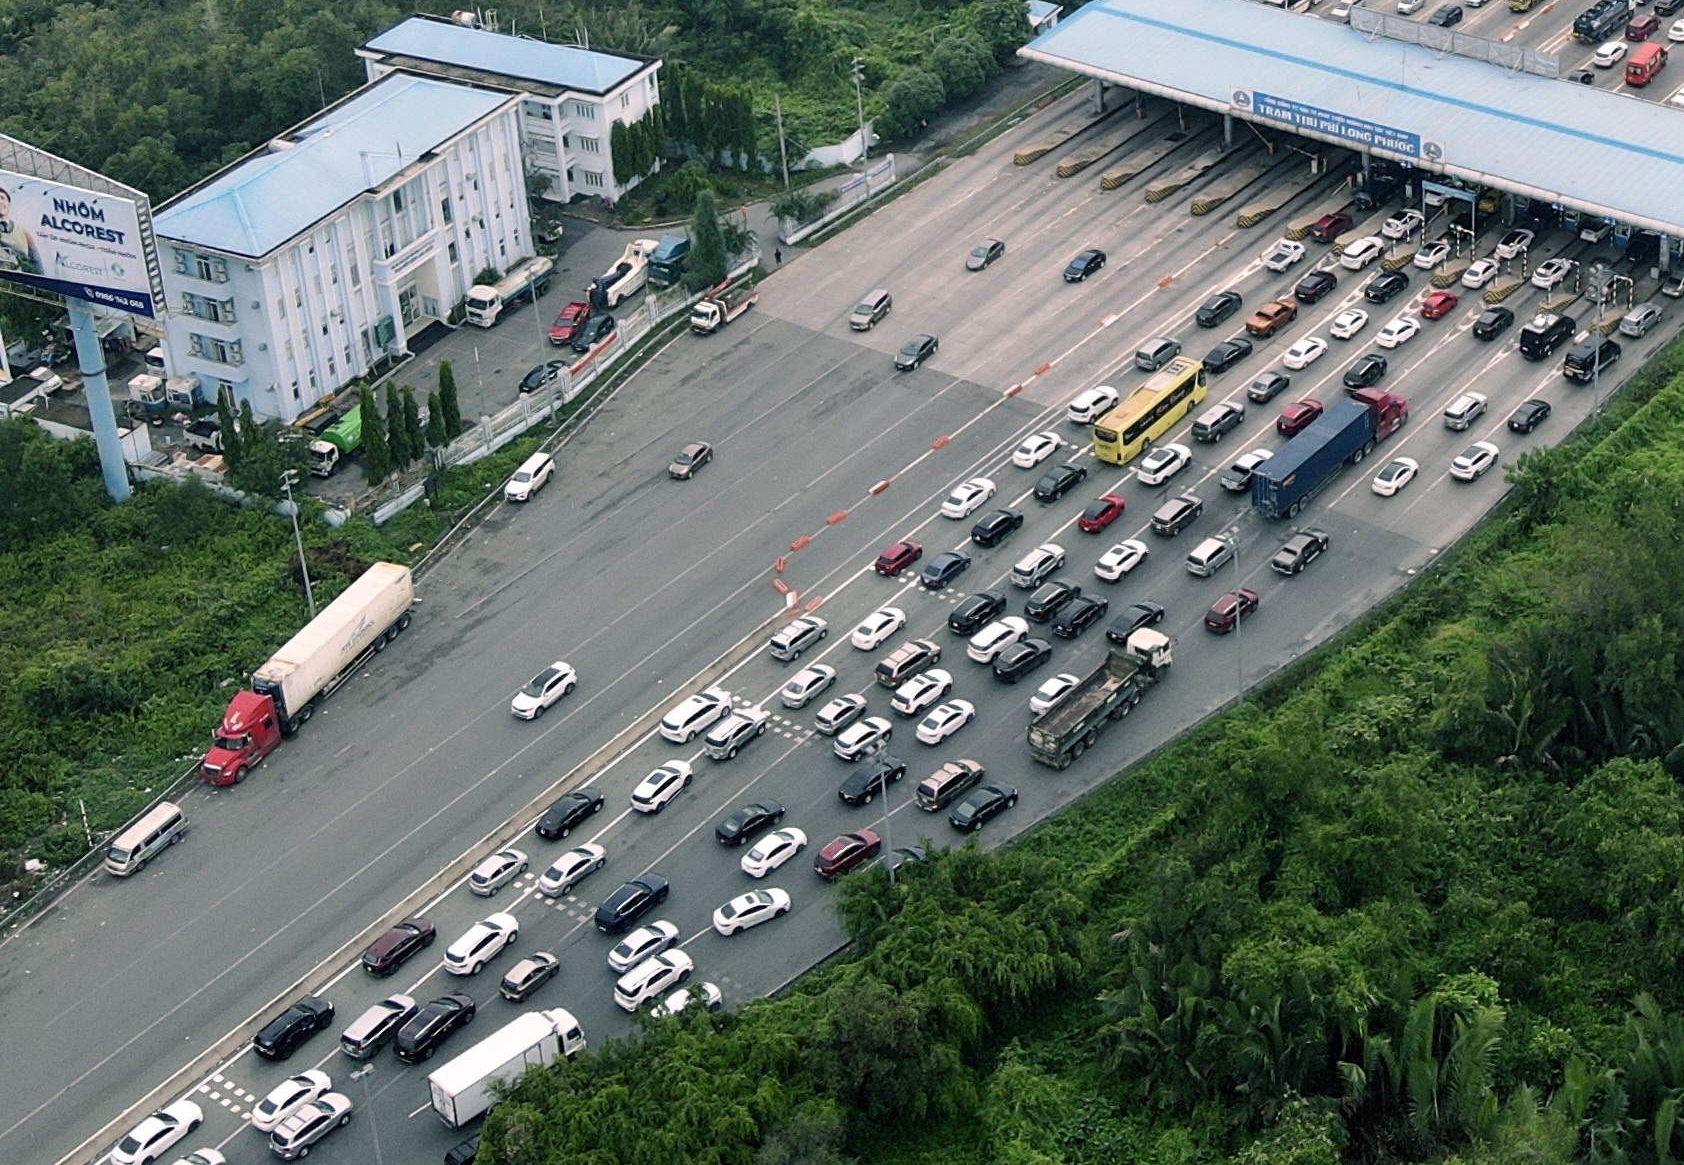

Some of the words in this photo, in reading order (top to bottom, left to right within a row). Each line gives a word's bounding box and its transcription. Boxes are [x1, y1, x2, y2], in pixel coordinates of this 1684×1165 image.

[1294, 113, 1318, 128] THU
[1320, 120, 1340, 134] PHÍ
[1341, 125, 1372, 142] LONG
[1374, 134, 1415, 154] PHƯỚC
[53, 197, 105, 223] NHÔM
[41, 213, 125, 245] ALCOREST
